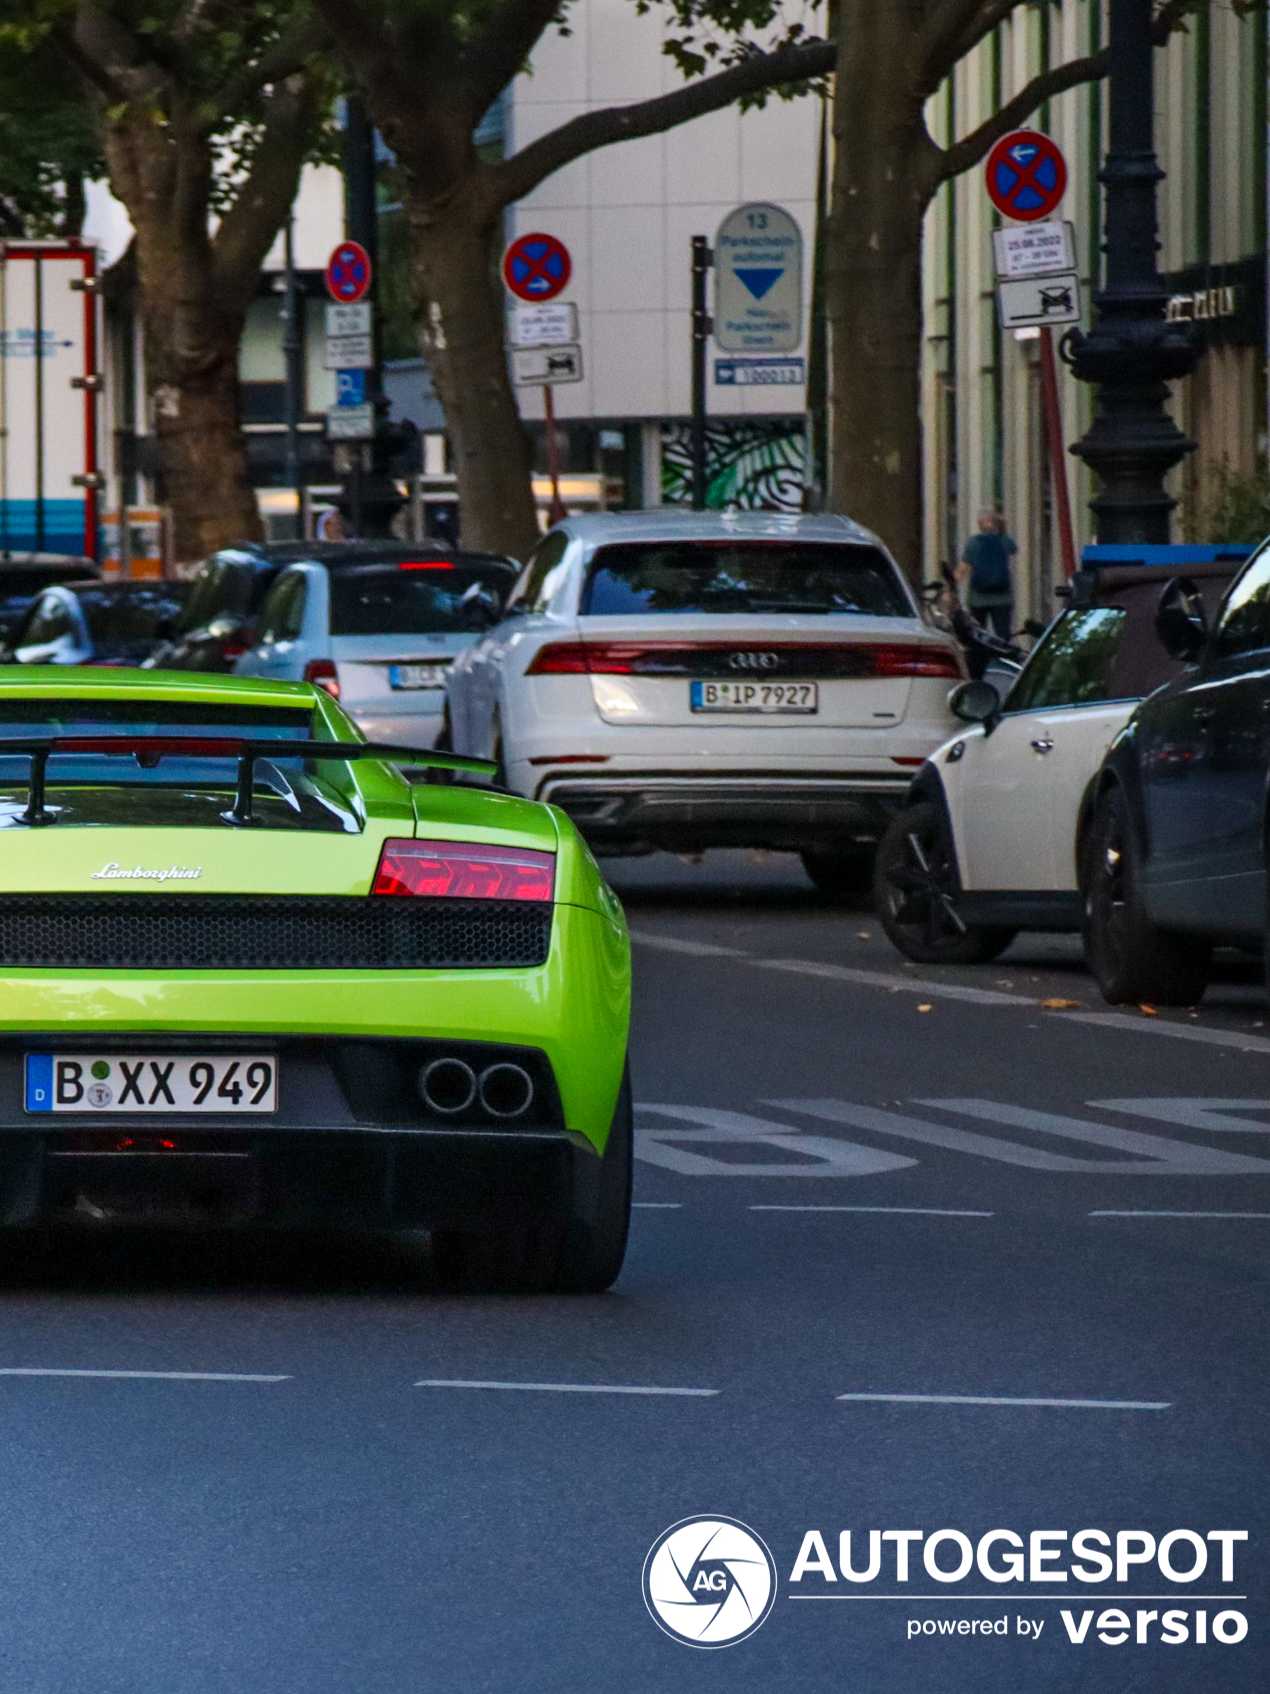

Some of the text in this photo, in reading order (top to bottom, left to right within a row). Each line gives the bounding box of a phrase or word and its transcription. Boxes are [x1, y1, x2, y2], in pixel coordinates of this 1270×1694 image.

[747, 213, 768, 229] 13
[706, 685, 811, 705] B IP 7927
[91, 862, 202, 883] Lamborghini
[56, 1061, 273, 1105] B XX 949
[35, 1088, 46, 1101] D
